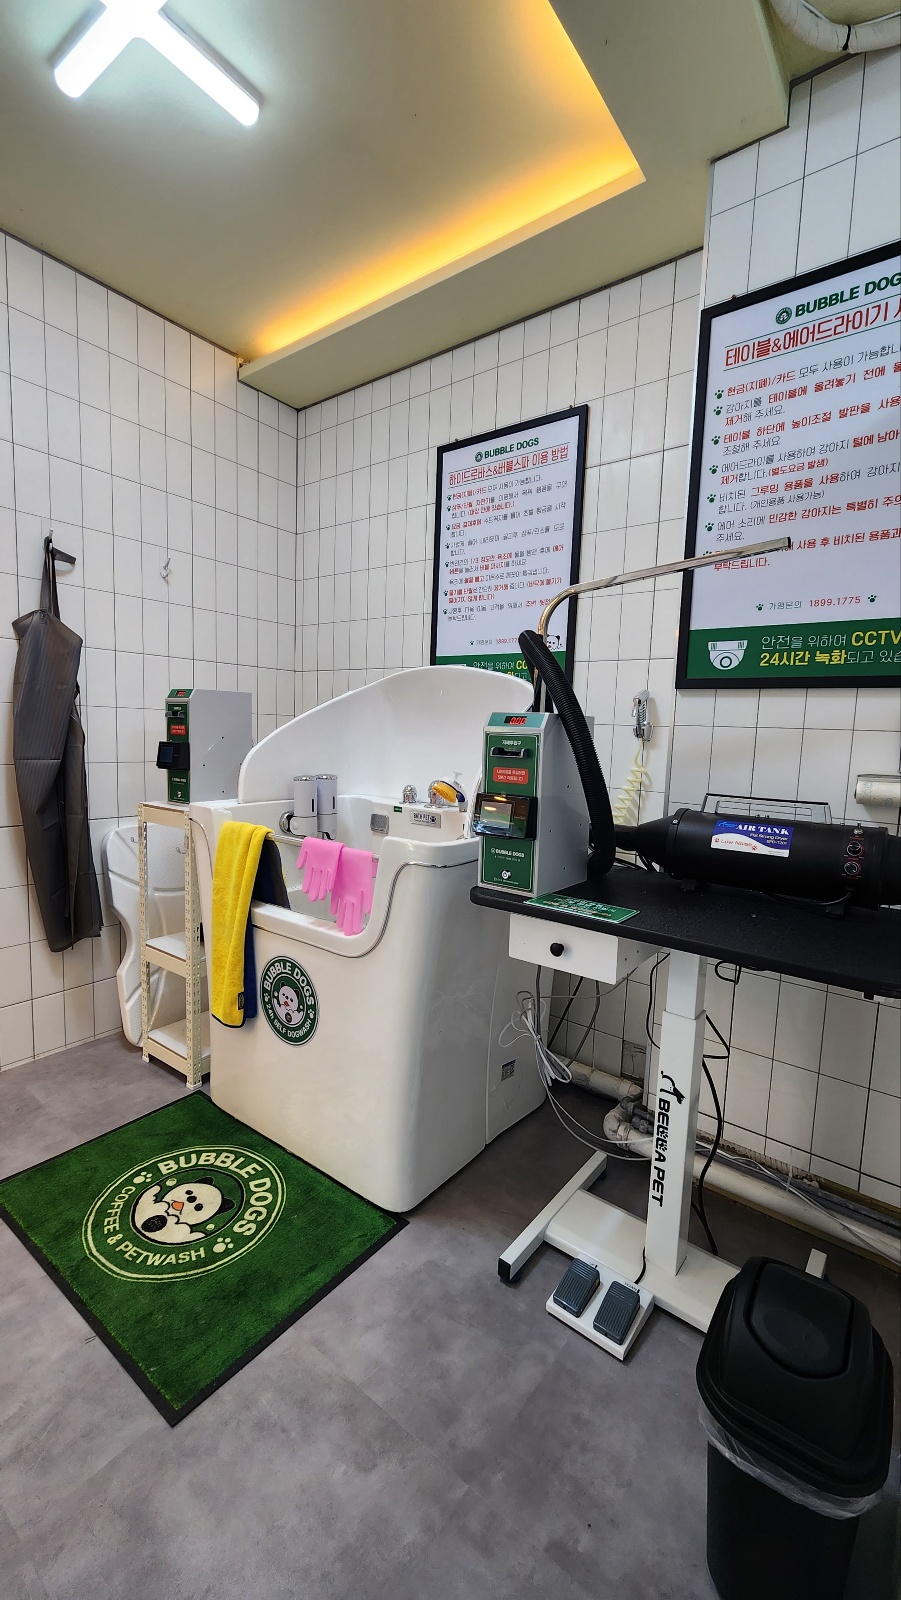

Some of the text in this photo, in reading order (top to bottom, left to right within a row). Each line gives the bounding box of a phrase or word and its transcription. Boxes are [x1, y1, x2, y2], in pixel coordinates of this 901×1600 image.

[795, 285, 860, 317] BUBBLE
[725, 301, 889, 367] 테이블&에어드라이기
[799, 364, 819, 379] 모두
[822, 355, 854, 372] 사용이
[726, 397, 762, 414] 강아지를
[768, 385, 808, 404] 테이블에
[814, 373, 856, 393] 올려놓기
[863, 366, 886, 381] 전에
[723, 430, 751, 444] 테이블
[757, 422, 785, 437] 하단에
[792, 411, 832, 430] 높이조절
[839, 402, 871, 419] 발판을
[725, 412, 752, 426] 제거해
[485, 437, 539, 459] BUBBLE DOGS
[532, 450, 548, 465] 이용
[551, 445, 569, 461] 방법
[723, 443, 750, 457] 조절해
[777, 446, 816, 463] 사용하여
[818, 439, 849, 454] 강아지
[852, 434, 874, 448] 털에
[719, 490, 746, 503] 비치된
[750, 484, 780, 498] 그루밍
[784, 478, 814, 492] 용품을
[819, 469, 861, 486] 사용하여
[717, 519, 735, 531] 에어
[738, 515, 766, 529] 소리에
[769, 510, 798, 524] 민감한
[801, 504, 841, 520] 강아지는
[846, 498, 878, 512] 특별히
[718, 502, 747, 515] 합니다.
[716, 531, 745, 543] 주세요.
[797, 539, 817, 550] 사용
[820, 536, 830, 547] 후
[833, 532, 865, 545] 비치된
[714, 557, 771, 571] 부탁드립니다.
[809, 595, 861, 608] 1899.1775
[761, 630, 901, 650] 안전을 위하여 CCTV
[495, 661, 515, 670] 위하여
[759, 651, 810, 667] 24시간
[814, 650, 874, 666] 녹화되고
[735, 824, 756, 832] AIR
[758, 826, 790, 836] TANK
[263, 962, 315, 1006] BUBBLE DOGS
[273, 1019, 287, 1034] SELF
[287, 1018, 312, 1038] DOGWASH
[651, 1097, 671, 1207] BELLA PET
[157, 1151, 273, 1236] BUBBLE DOGS
[103, 1184, 206, 1266] COFFEE & PETWASH
